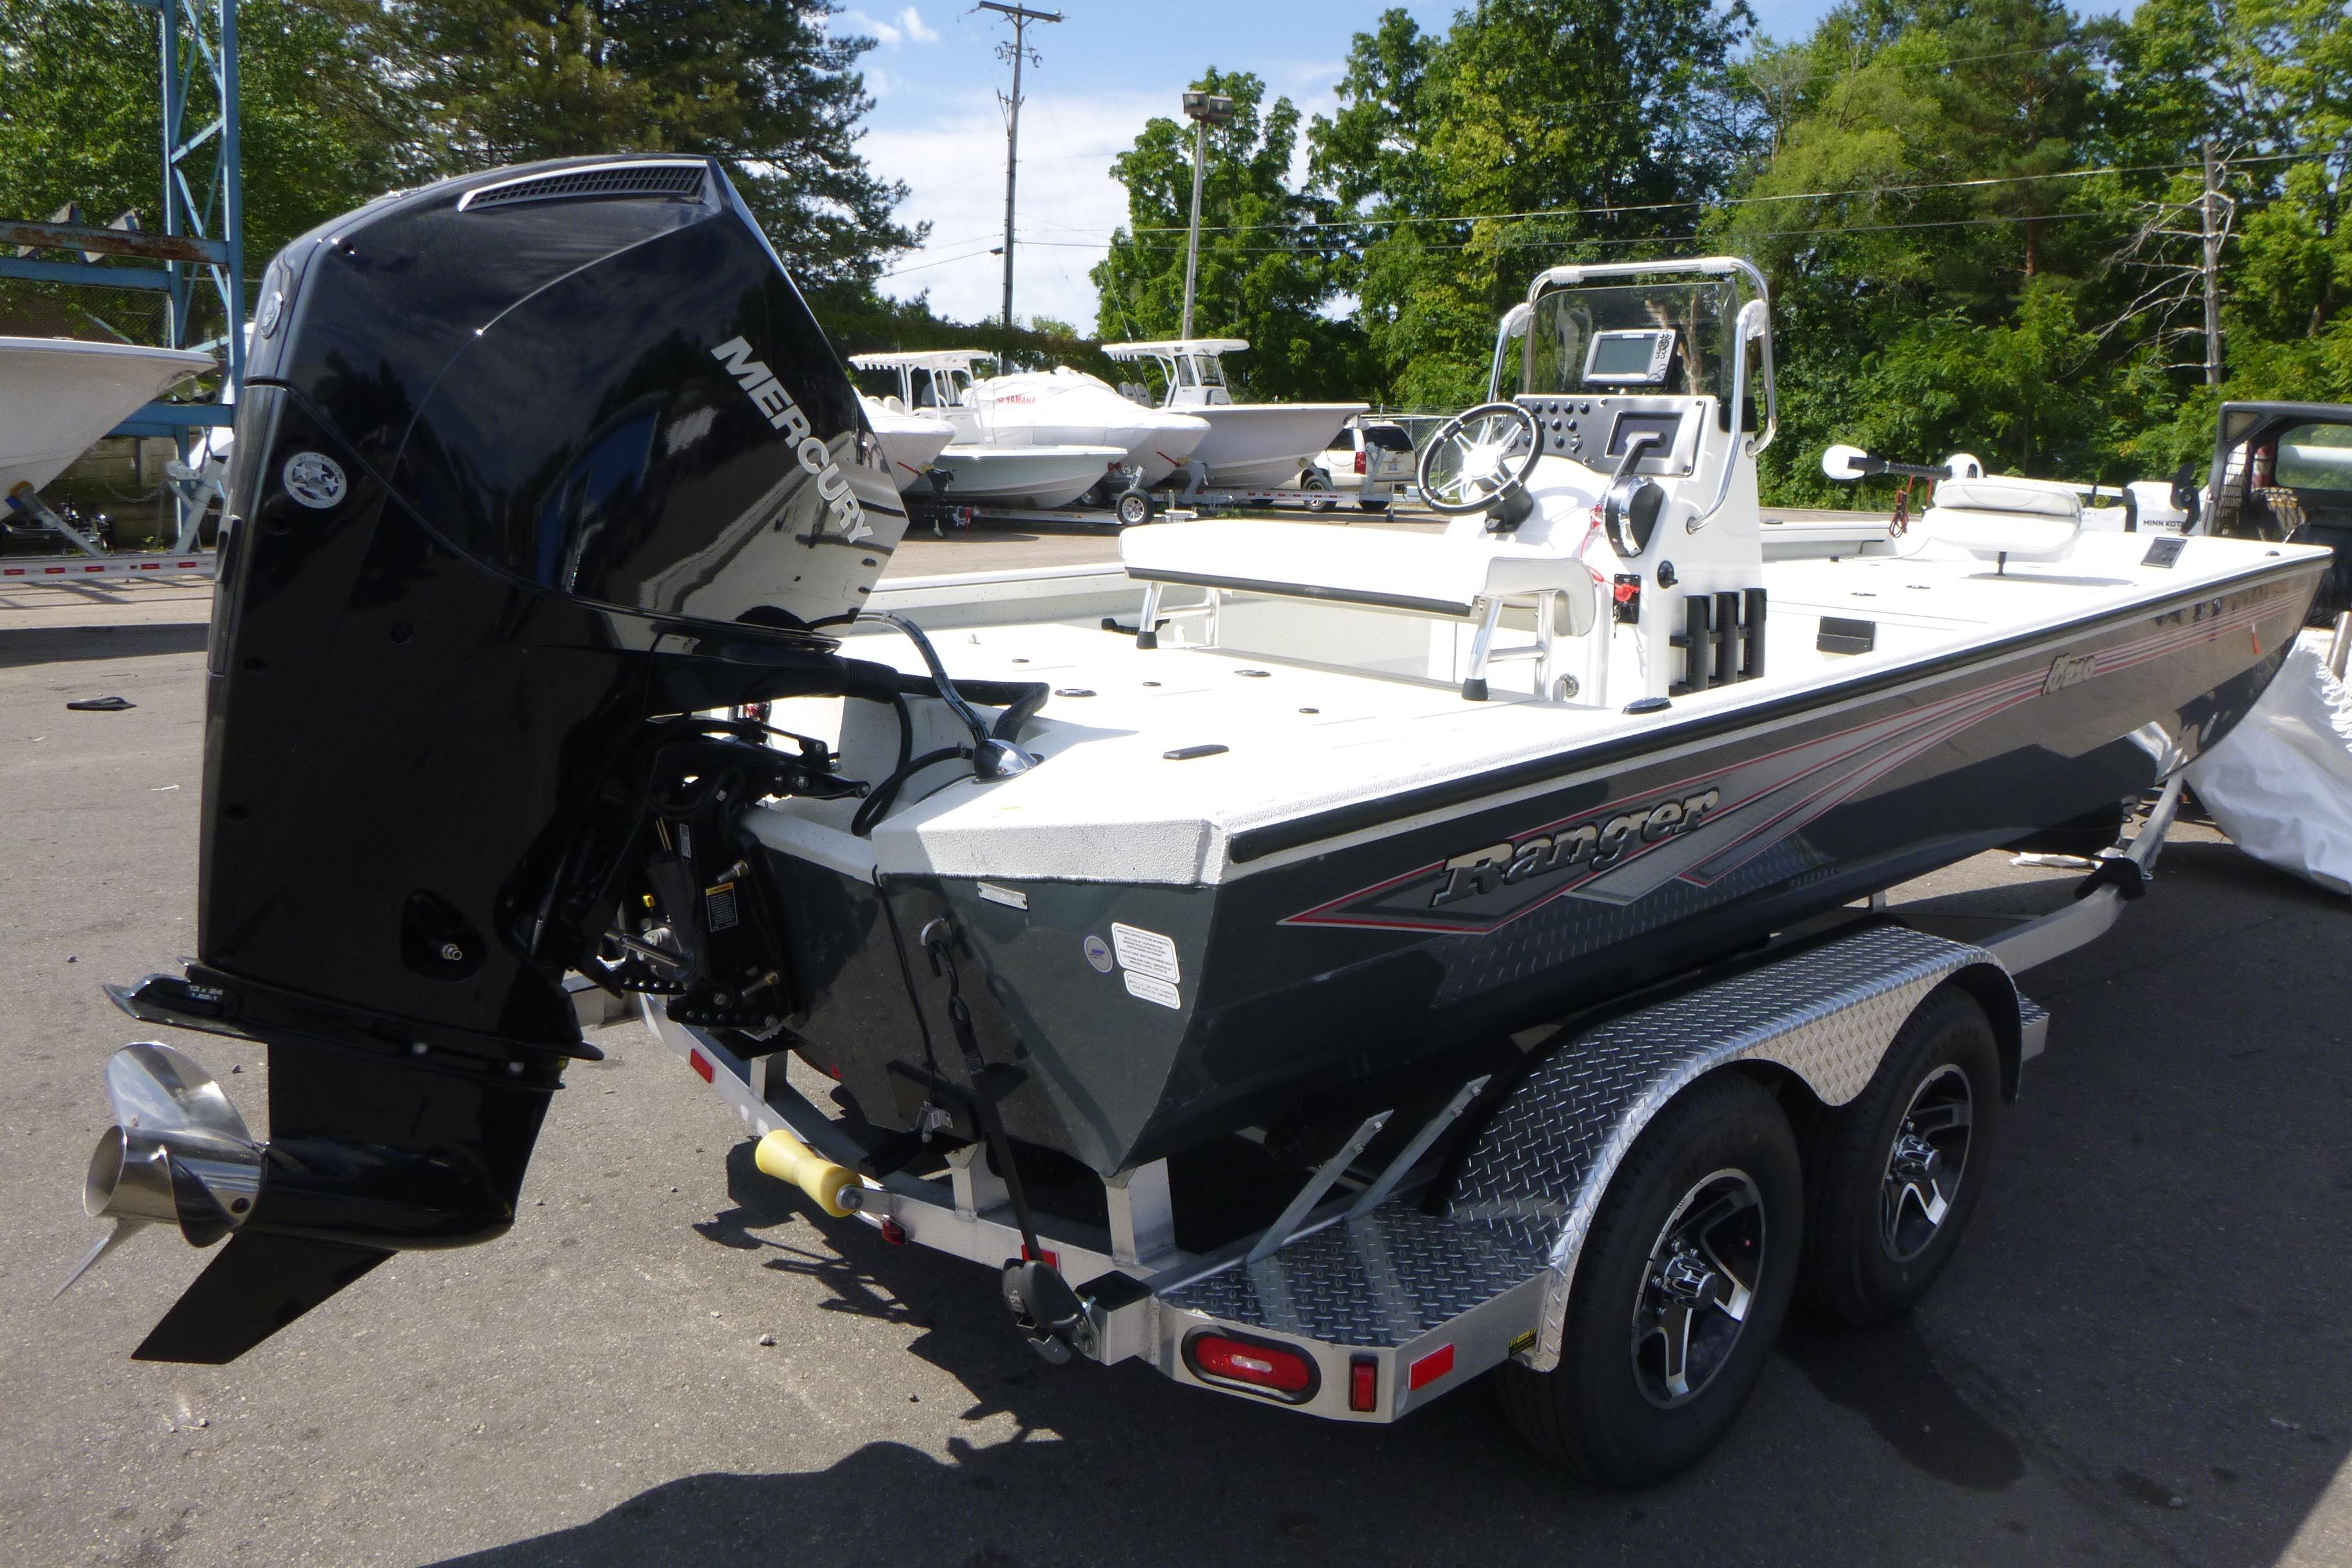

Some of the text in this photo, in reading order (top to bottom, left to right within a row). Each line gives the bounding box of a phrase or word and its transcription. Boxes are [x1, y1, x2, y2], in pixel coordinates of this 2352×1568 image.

[710, 335, 874, 544] MERCURY
[1006, 395, 1035, 404] YAMAHA
[1428, 786, 1720, 908] Ranger
